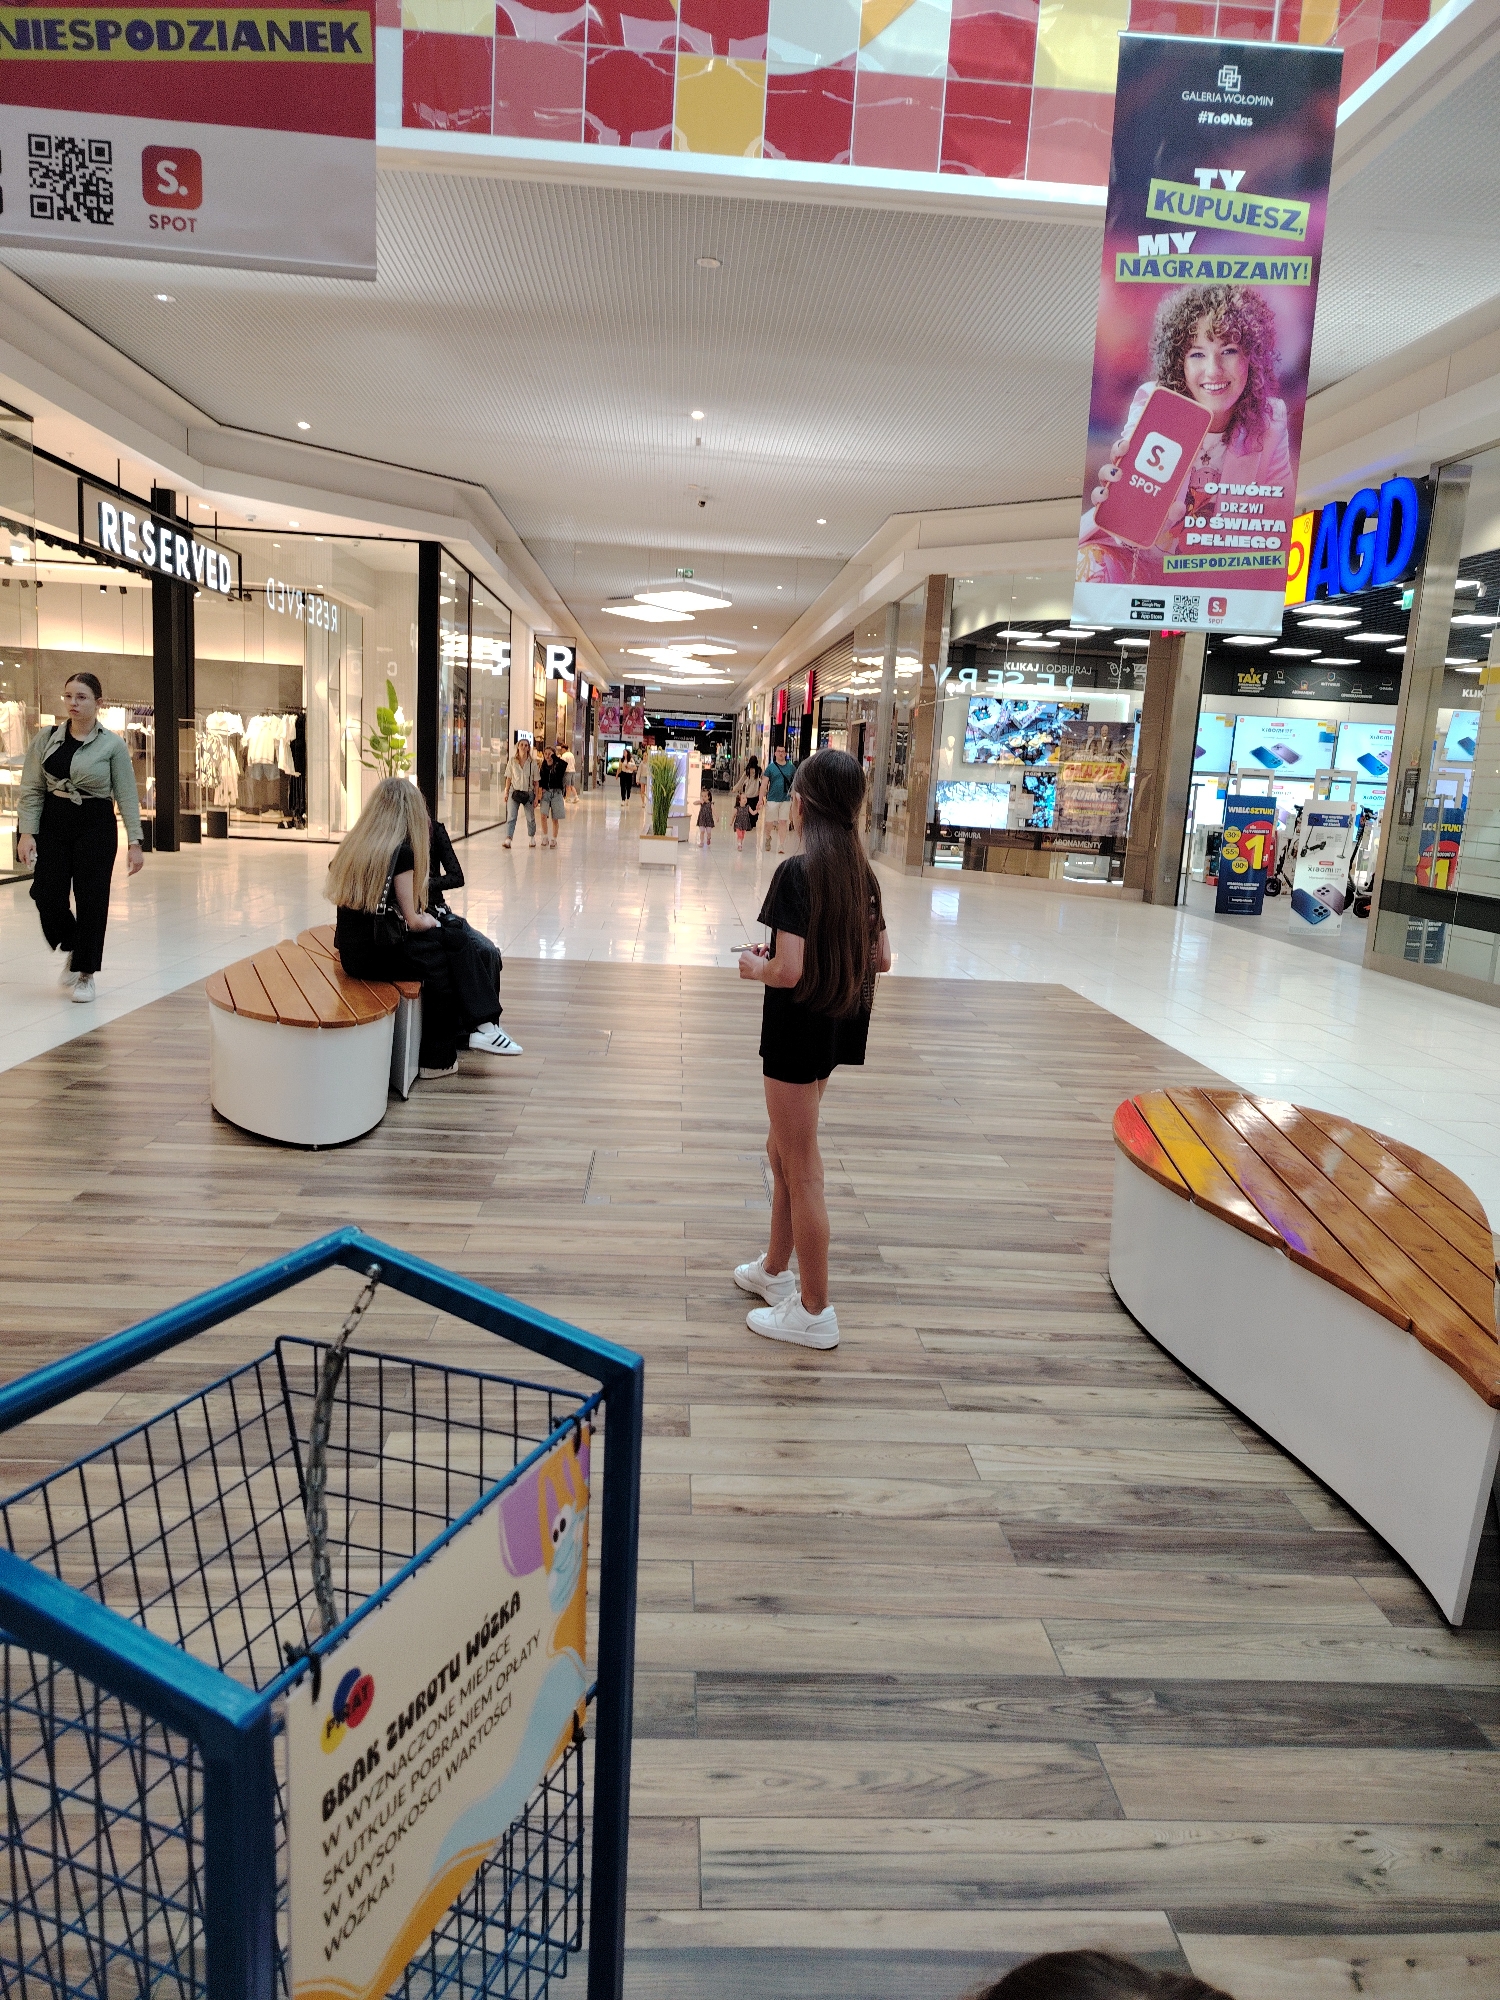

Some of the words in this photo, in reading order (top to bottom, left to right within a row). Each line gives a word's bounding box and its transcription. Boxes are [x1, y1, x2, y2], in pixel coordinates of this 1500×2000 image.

[0, 19, 362, 53] NIESPODZIANEK
[1181, 90, 1222, 104] GALERIA
[1223, 93, 1274, 106] WOŁOMIN
[1194, 168, 1246, 191] TY
[149, 214, 197, 232] SPOT
[1154, 189, 1304, 236] KUPUJESZ,
[1138, 231, 1197, 256] MY
[1119, 258, 1308, 280] NAGRADZAMY!
[1129, 474, 1161, 497] SPOT
[1204, 481, 1284, 498] OTWÓRZ
[1220, 501, 1264, 514] DRZWI
[1184, 516, 1207, 528] DO
[1209, 514, 1286, 533] ŚWIATA
[99, 501, 232, 594] RESERVED
[1186, 533, 1281, 550] PEŁNEGO
[1305, 477, 1418, 602] AGD
[1166, 554, 1282, 570] NIESPODZIANEK
[546, 645, 574, 681] R
[1003, 661, 1040, 672] KLIKAJ
[1046, 663, 1092, 675] ODBIERAJ
[954, 830, 981, 840] CHMURA
[1052, 838, 1102, 849] ABONAMENTY
[1245, 834, 1265, 870] 1
[322, 1739, 380, 1822] BRAK
[387, 1651, 461, 1751] ZWROTU
[466, 1590, 521, 1666] WÓZKA
[322, 1823, 341, 1858] W
[346, 1696, 456, 1830] WYZNACZONE
[459, 1634, 511, 1705] MIEJSCE
[323, 1783, 407, 1895] SKUTKUJE
[411, 1685, 493, 1793] POBRANIEM
[496, 1628, 541, 1691] OPŁATY
[323, 1892, 342, 1927] W
[347, 1775, 442, 1899] WYSOKOŚCI
[445, 1691, 513, 1782] WARTOŚCI
[324, 1862, 395, 1962] WÓZKA!
